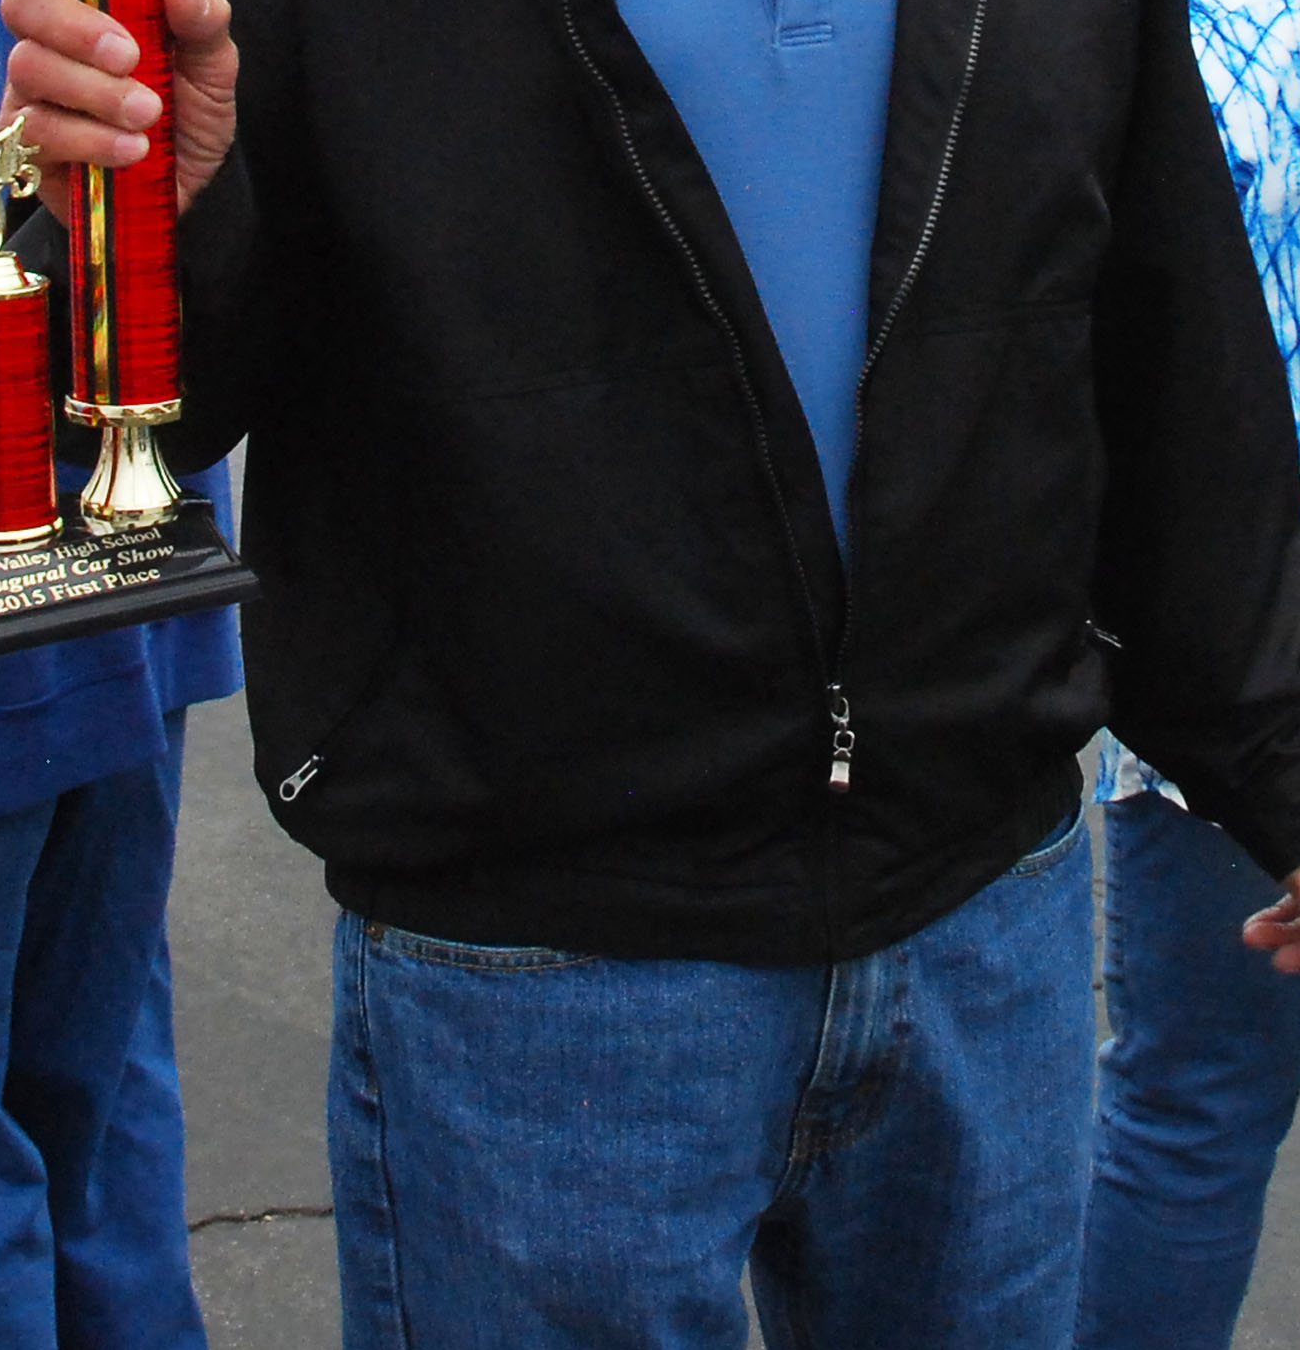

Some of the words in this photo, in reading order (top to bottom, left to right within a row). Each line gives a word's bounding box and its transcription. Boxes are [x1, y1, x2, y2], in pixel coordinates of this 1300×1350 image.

[54, 541, 100, 560] High
[101, 527, 162, 550] School
[71, 558, 112, 576] Car
[117, 544, 175, 567] Show
[49, 580, 101, 601] First
[103, 568, 161, 589] Place
